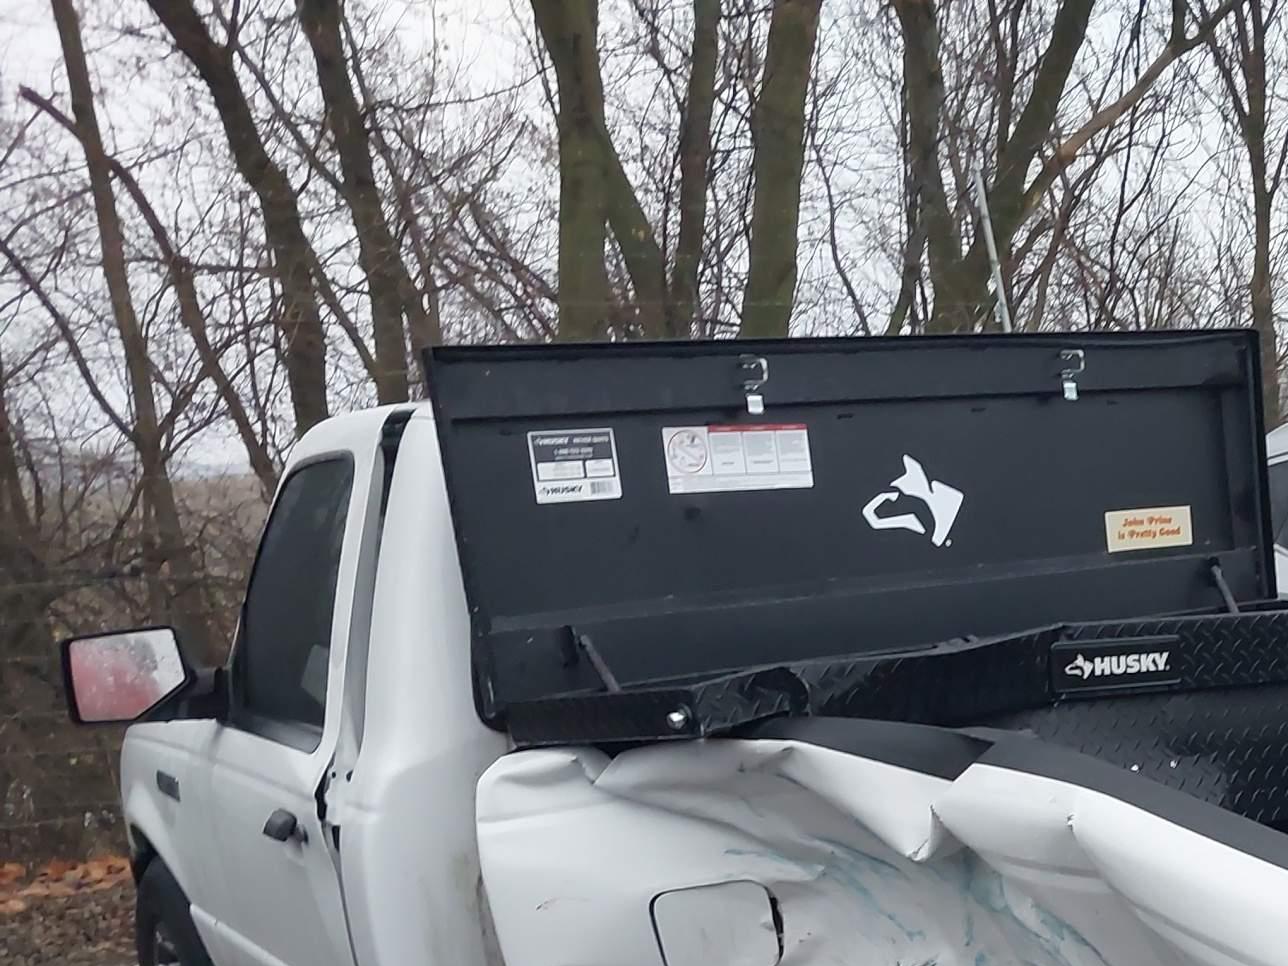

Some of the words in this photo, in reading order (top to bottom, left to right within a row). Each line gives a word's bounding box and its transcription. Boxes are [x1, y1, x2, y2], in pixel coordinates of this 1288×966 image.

[1122, 517, 1145, 528] John
[1128, 528, 1157, 540] Pretty
[1160, 525, 1181, 537] Good
[1094, 651, 1169, 676] HUSKY
